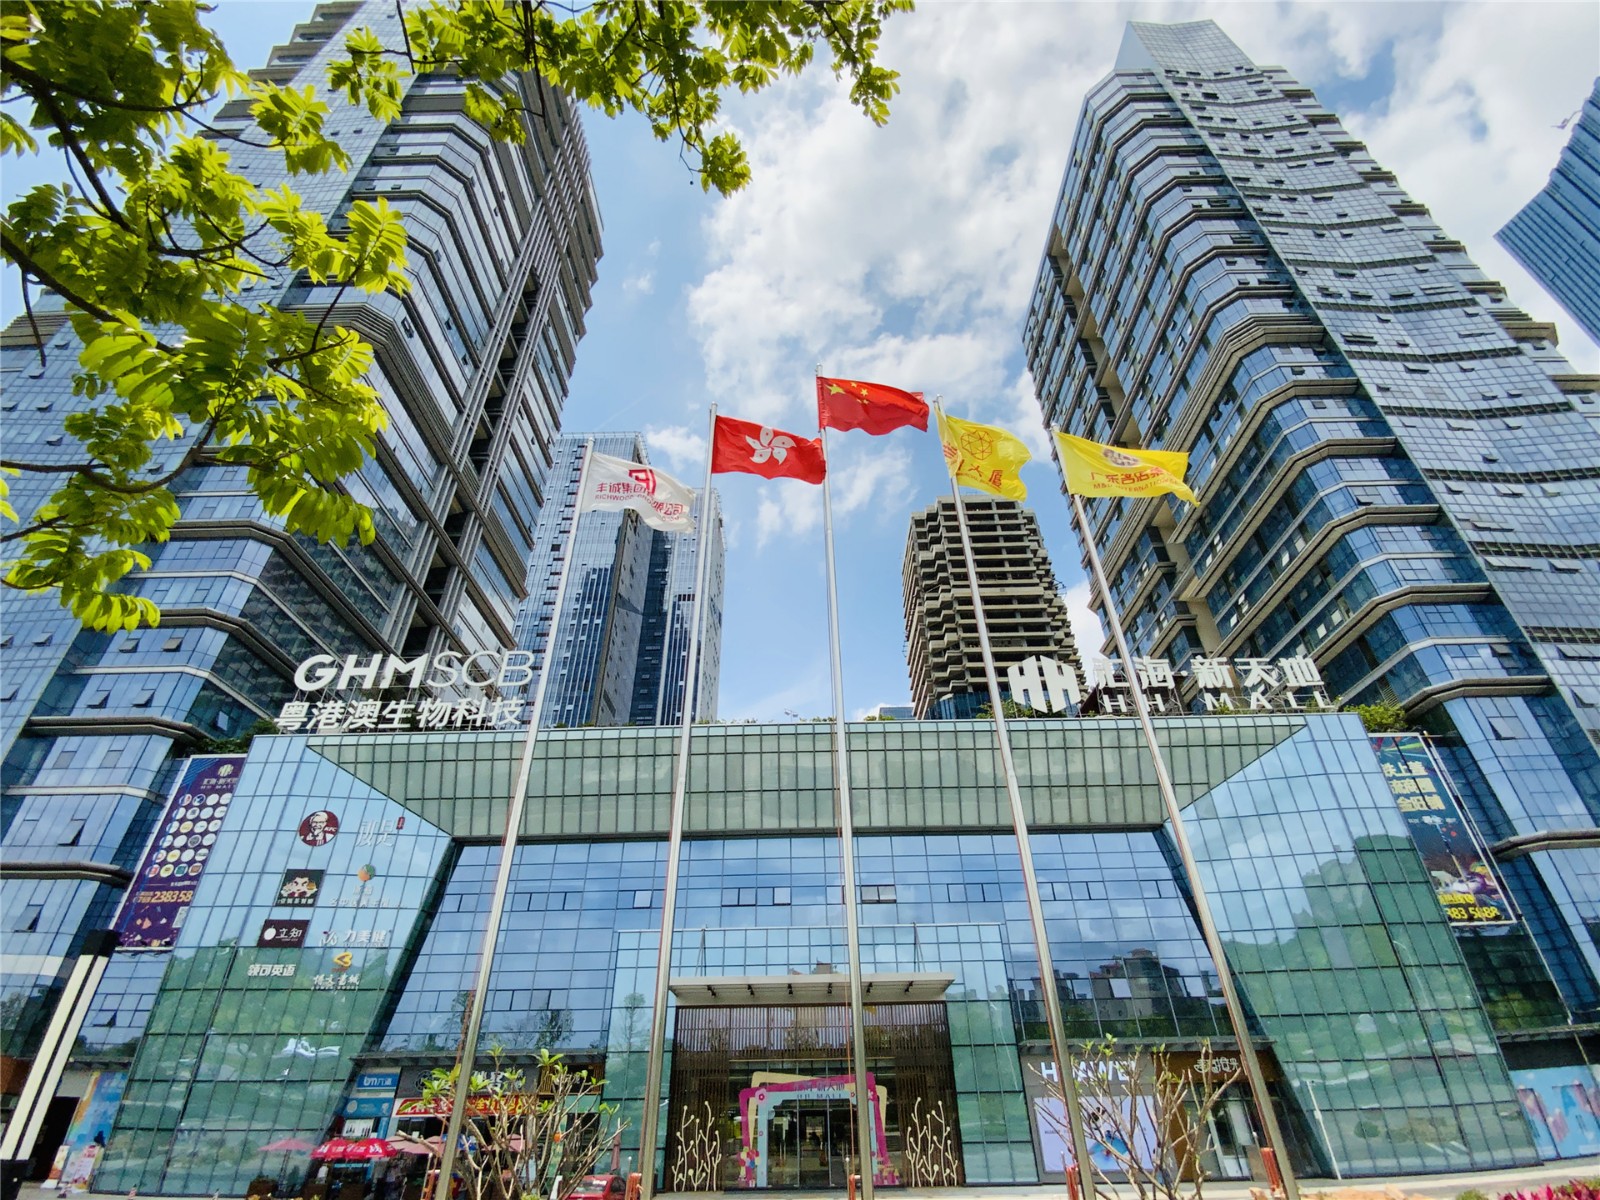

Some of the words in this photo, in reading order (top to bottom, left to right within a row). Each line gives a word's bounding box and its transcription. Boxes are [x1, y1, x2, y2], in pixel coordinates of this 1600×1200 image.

[294, 650, 535, 691] GHMSCB
[274, 697, 524, 730] 粤港澳生物科技
